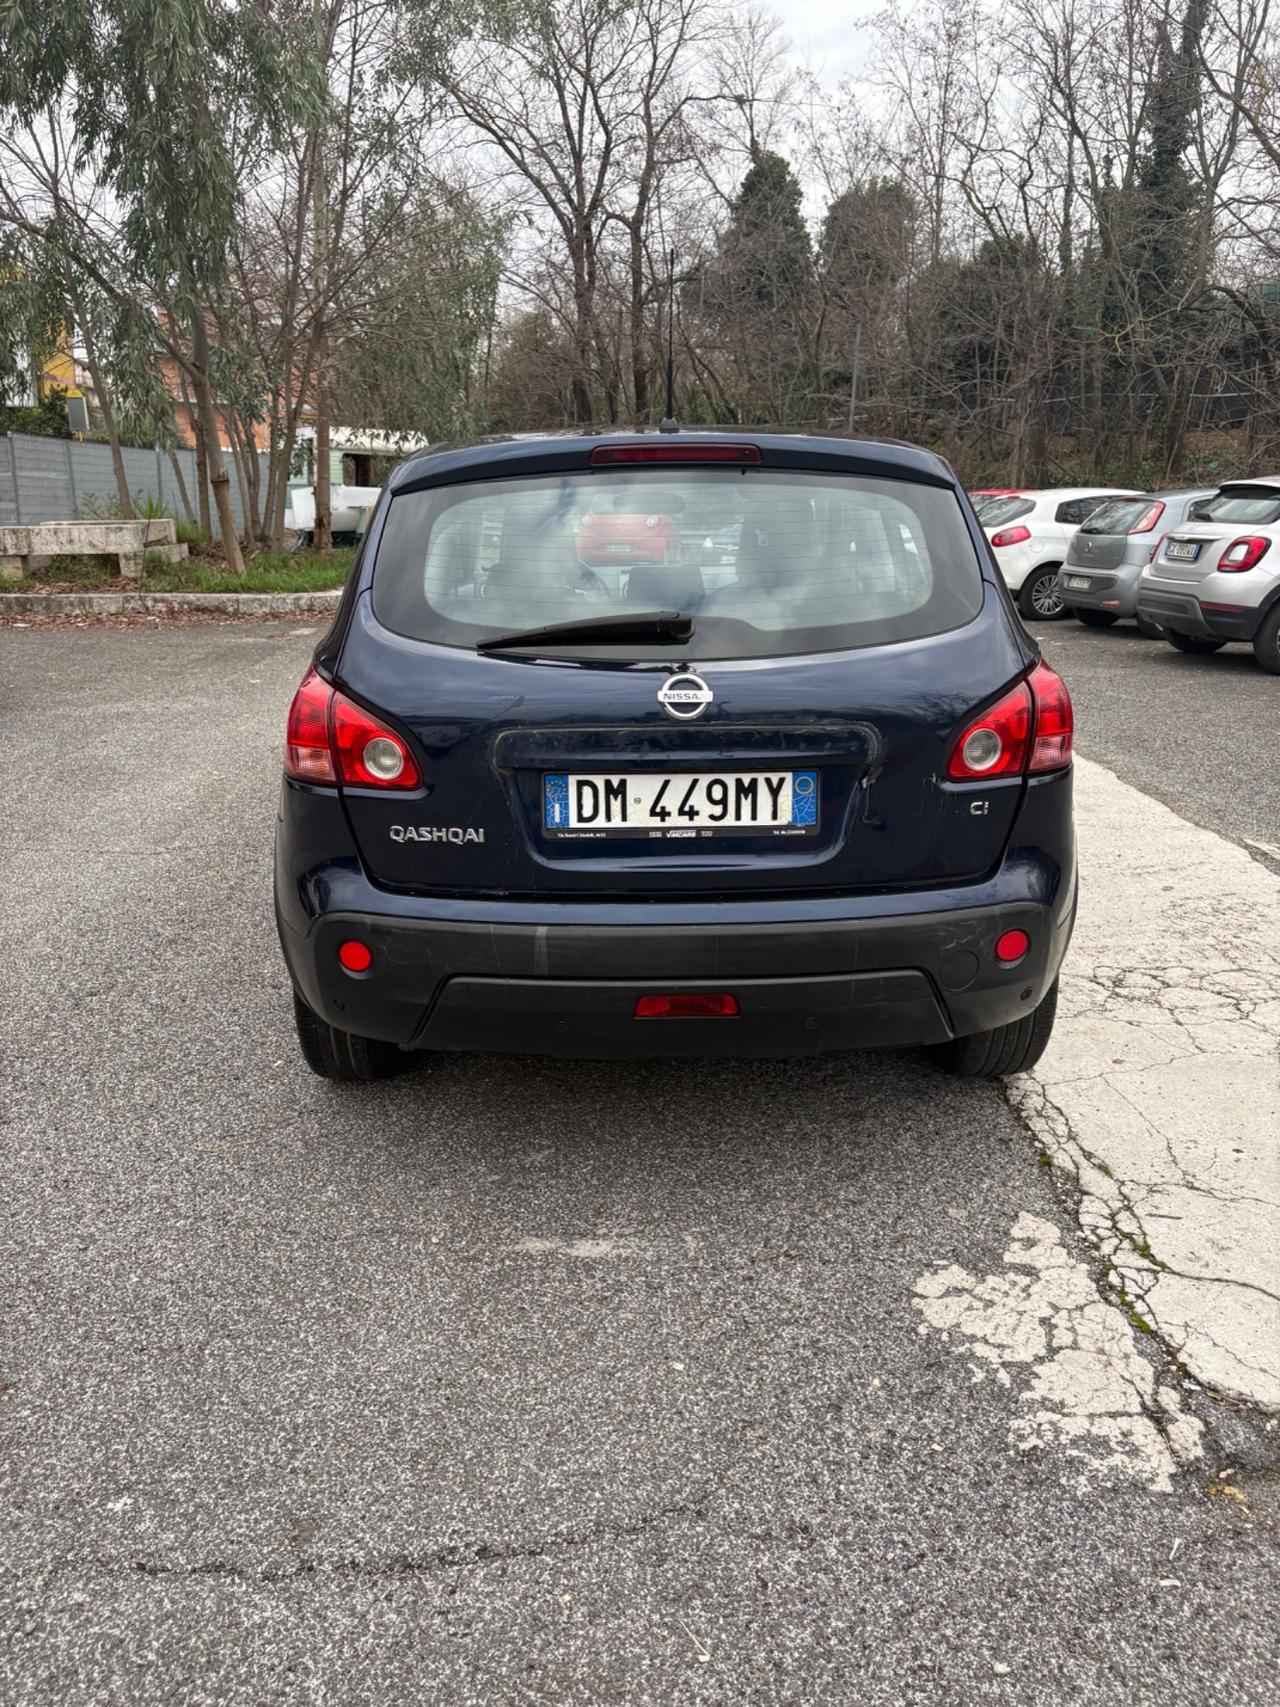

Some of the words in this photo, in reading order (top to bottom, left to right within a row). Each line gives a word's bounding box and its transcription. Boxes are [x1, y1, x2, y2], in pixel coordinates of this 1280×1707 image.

[575, 778, 628, 823] DM
[649, 776, 787, 823] 449MY
[389, 825, 486, 845] QASHQAI
